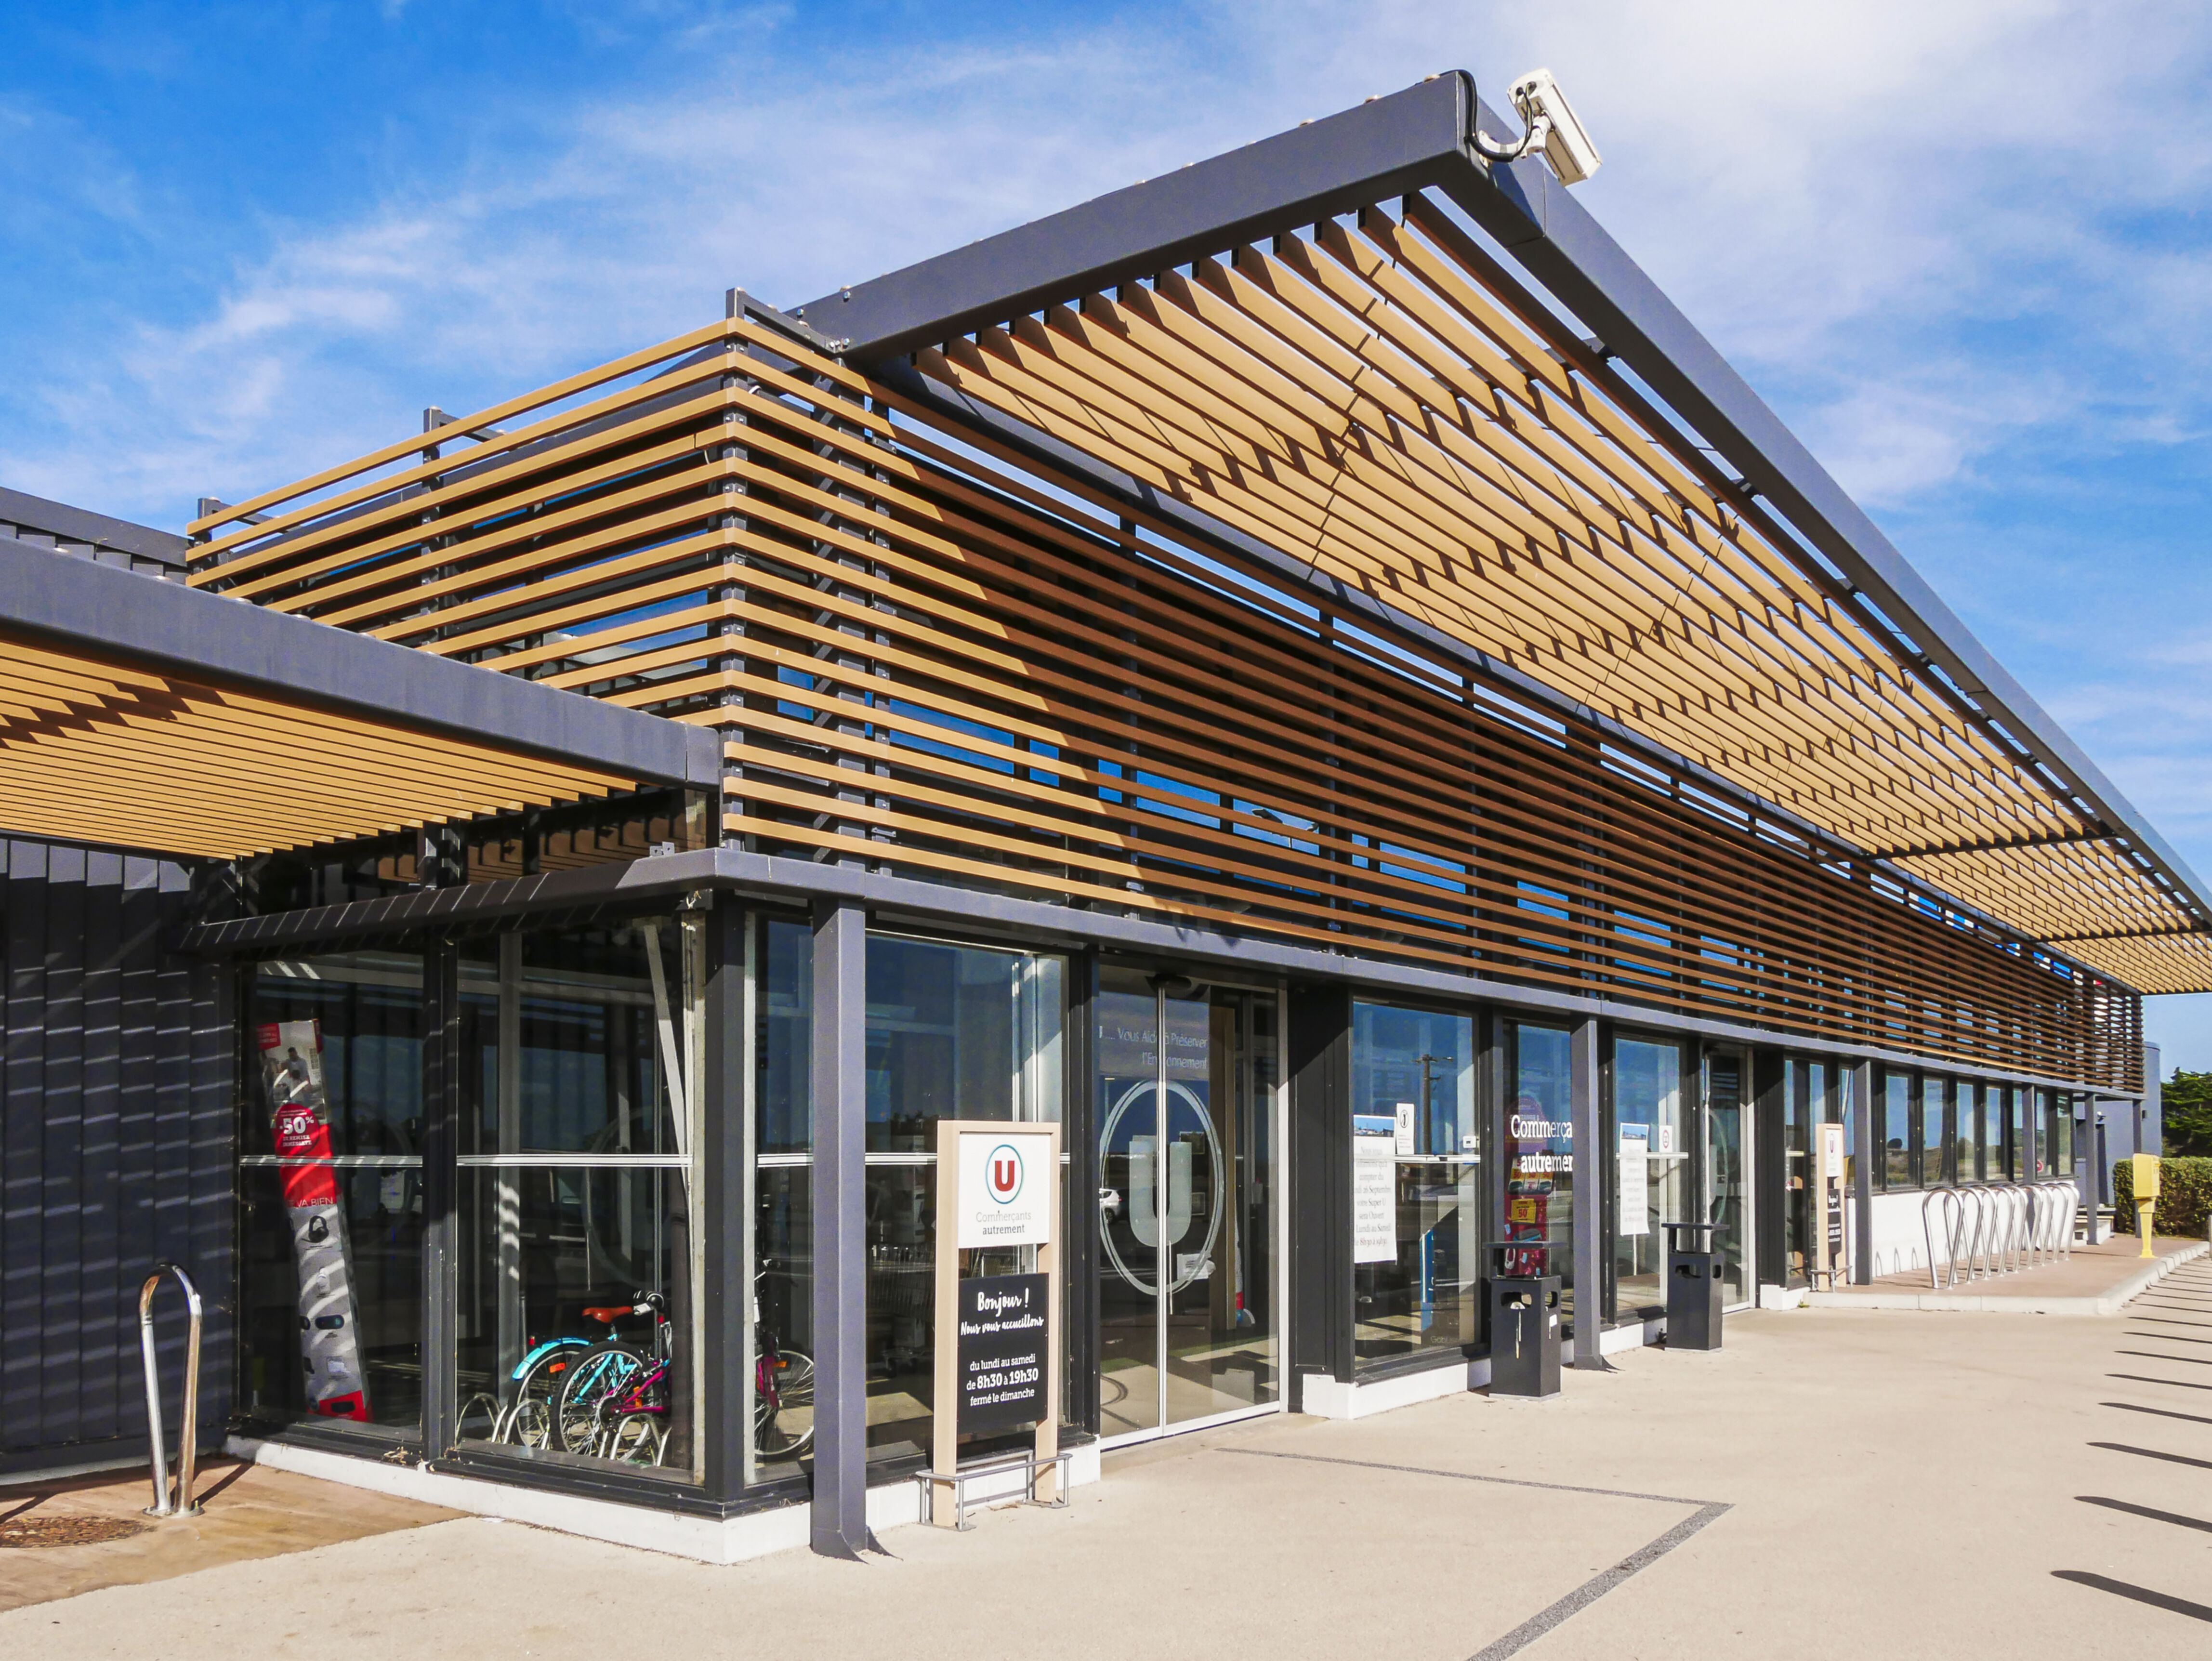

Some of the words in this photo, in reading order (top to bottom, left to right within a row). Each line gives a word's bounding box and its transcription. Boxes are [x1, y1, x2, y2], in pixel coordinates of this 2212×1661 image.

[1118, 1027, 1139, 1042] Vous
[1142, 1030, 1158, 1044] Aid
[1171, 1032, 1208, 1048] Préserver
[994, 1160, 1015, 1192] U
[297, 1199, 308, 1208] VA
[311, 1196, 333, 1206] BIEN
[1369, 1198, 1382, 1208] Super
[975, 1212, 1031, 1223] Commerçants
[1518, 1209, 1527, 1218] 50
[982, 1224, 1025, 1235] autrement
[977, 1291, 1022, 1317] Bonjour
[1025, 1288, 1029, 1308] !
[961, 1321, 981, 1336] Nous
[982, 1321, 1001, 1333] vous
[1001, 1313, 1044, 1330] accueillons
[970, 1361, 980, 1371] du
[981, 1358, 1000, 1370] lundi
[1001, 1359, 1010, 1368] au
[1011, 1353, 1036, 1366] samedi
[966, 1381, 976, 1391] de
[977, 1373, 1002, 1389] 8h30
[1003, 1375, 1008, 1385] à
[1009, 1368, 1039, 1385] 19h30
[970, 1394, 991, 1407] fermé
[992, 1393, 999, 1403] le
[1000, 1388, 1035, 1402] dimanche
